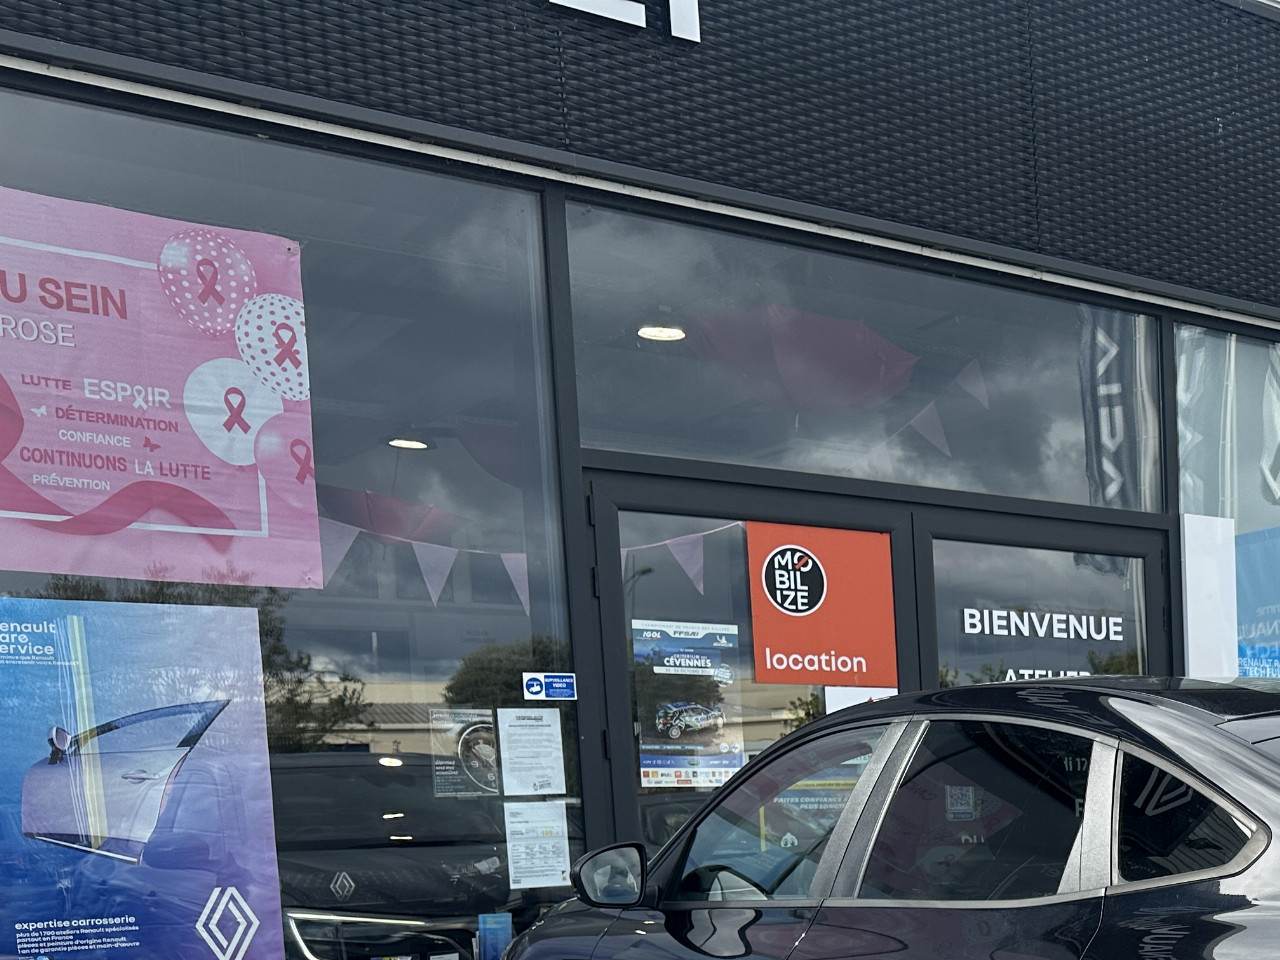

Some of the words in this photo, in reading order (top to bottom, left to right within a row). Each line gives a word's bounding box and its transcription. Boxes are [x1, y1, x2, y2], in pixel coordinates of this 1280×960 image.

[38, 277, 128, 320] SEIN
[0, 313, 76, 348] ROSE
[21, 373, 72, 391] LUTTE
[55, 405, 179, 433] DÉTERMINATION
[58, 429, 131, 448] CONFIANCE
[19, 446, 127, 473] CONTINUONS
[134, 458, 154, 476] LA
[159, 461, 211, 481] LUTTE
[32, 473, 110, 492] PRÉVENTION
[963, 607, 1124, 642] BIENVENUE
[664, 656, 711, 667] CÉVENNES
[765, 647, 867, 674] location
[15, 919, 70, 931] expertise
[72, 915, 136, 927] carrosserie
